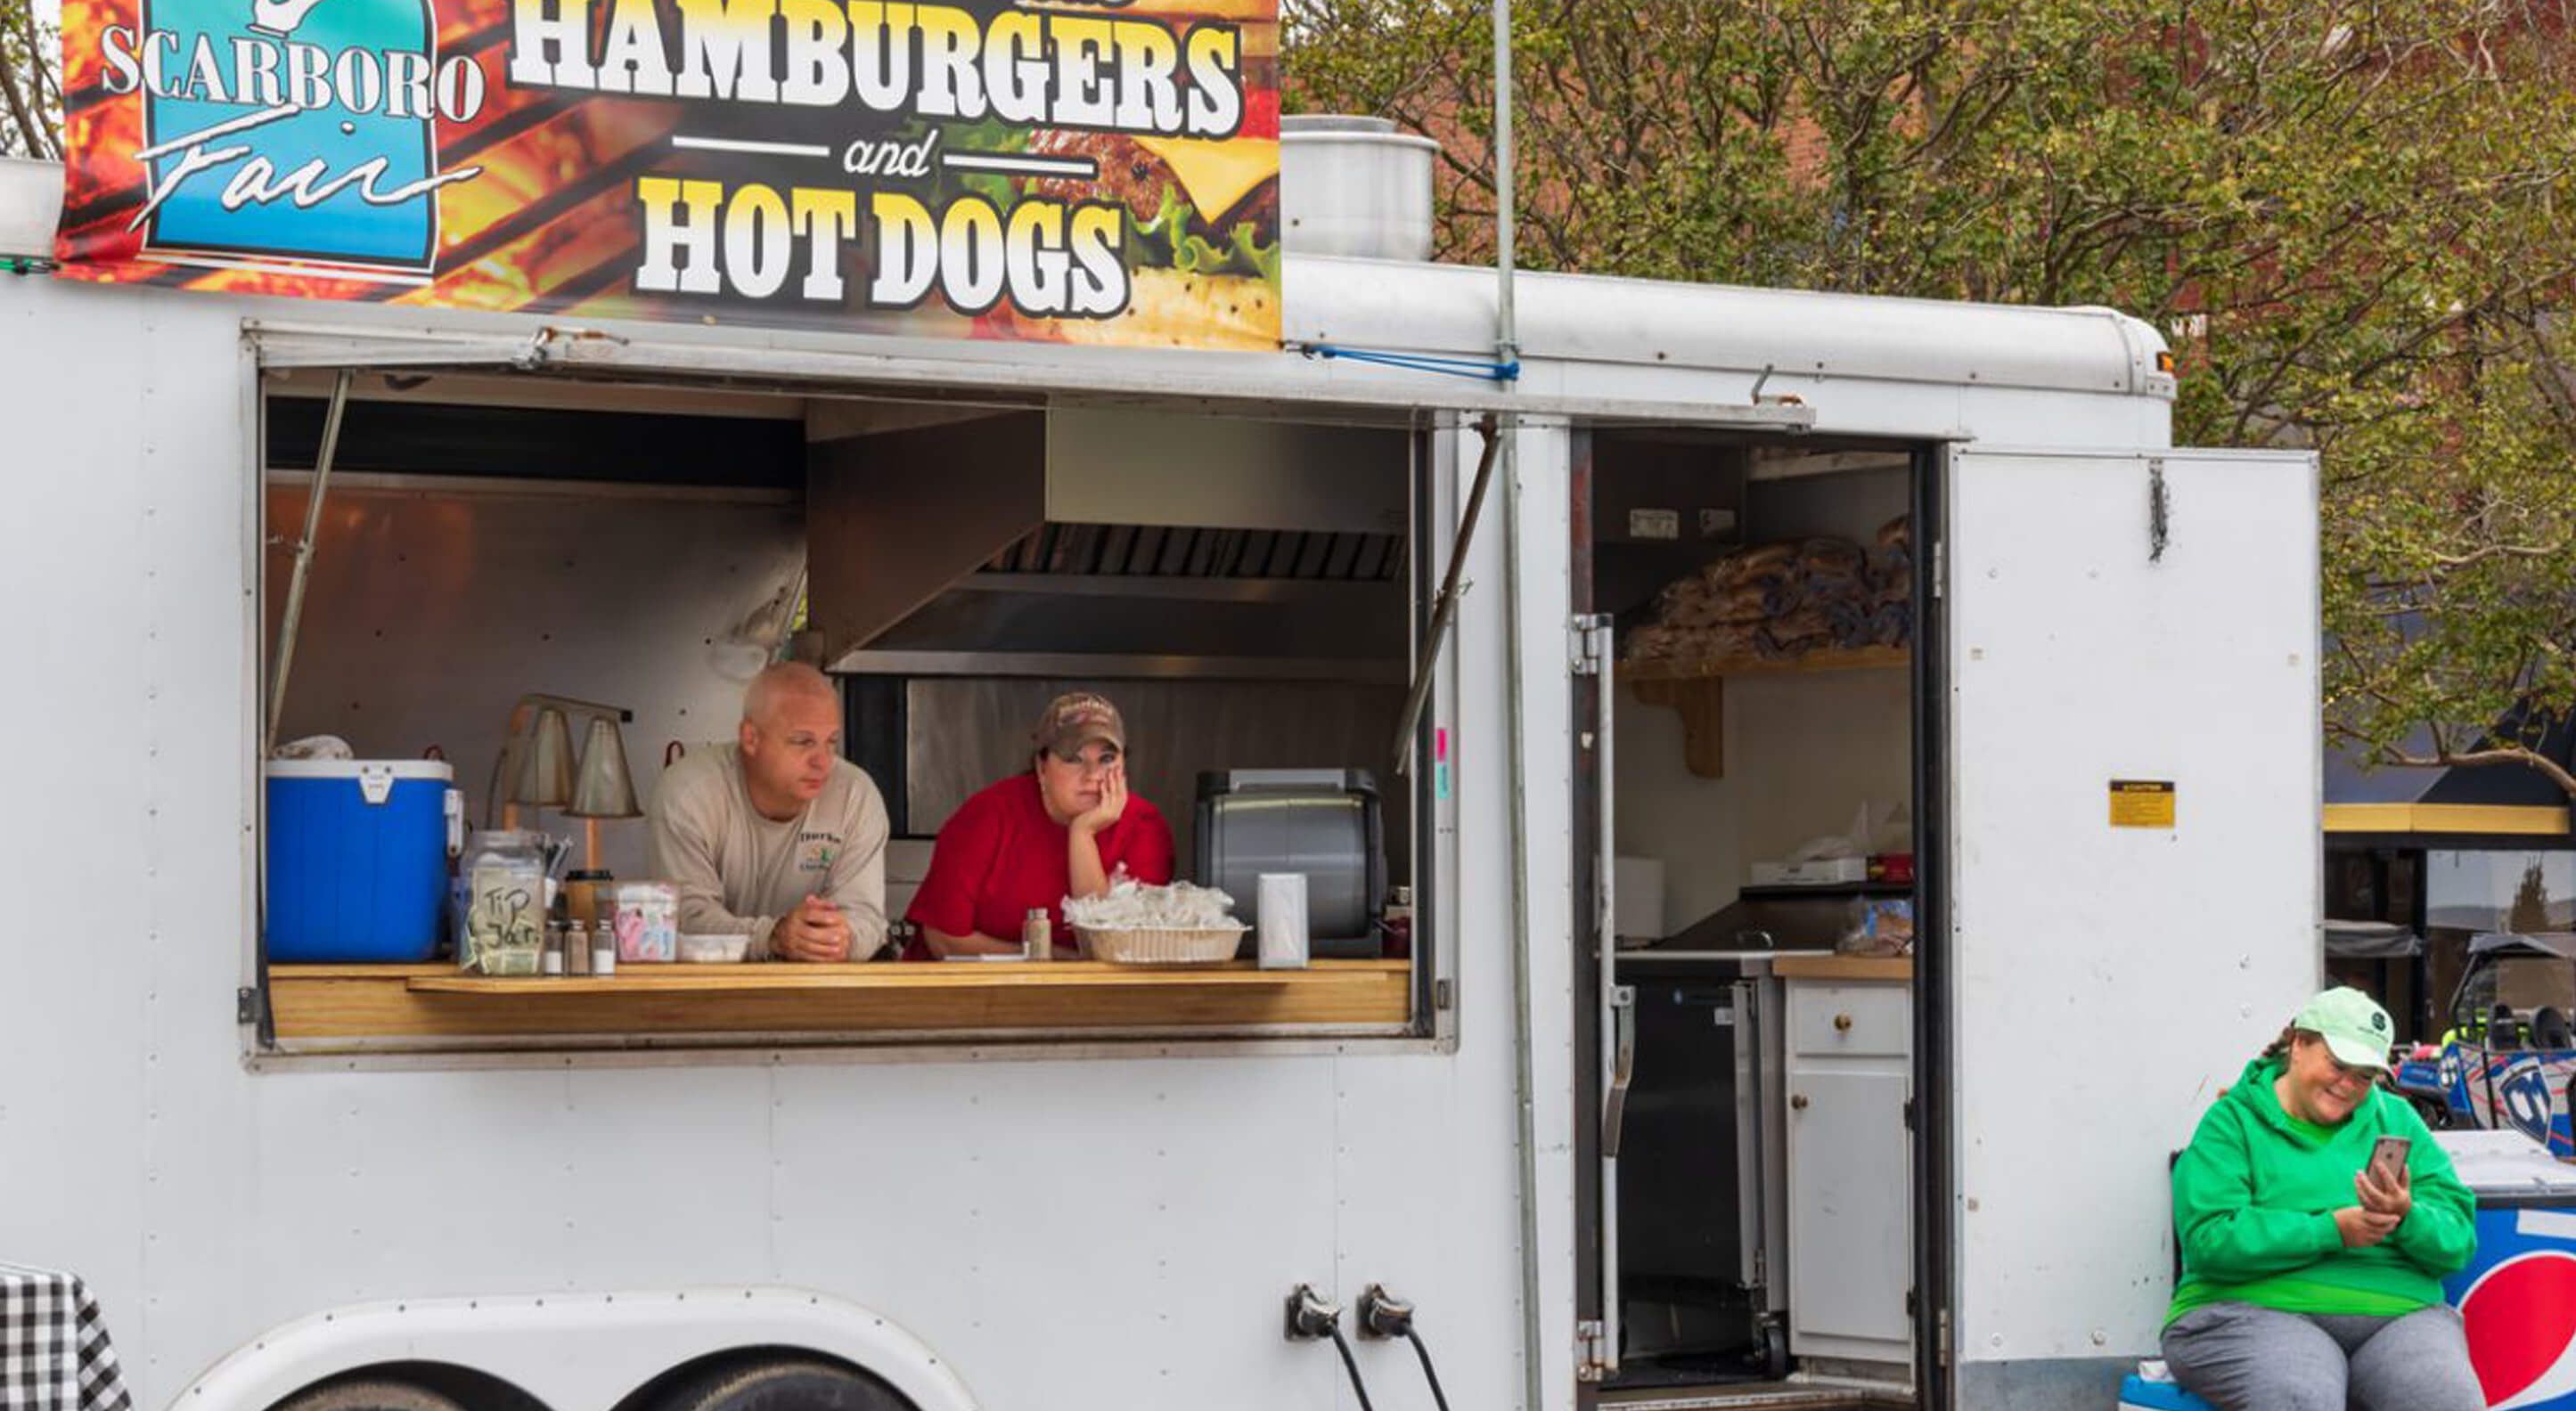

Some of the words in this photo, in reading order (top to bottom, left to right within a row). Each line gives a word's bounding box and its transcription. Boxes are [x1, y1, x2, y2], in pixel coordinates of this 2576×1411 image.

[100, 23, 485, 123] SCARBORO
[511, 0, 1242, 135] HAMBURGERS
[128, 102, 484, 234] Fair
[843, 128, 938, 177] and
[636, 177, 856, 302] HOT
[872, 192, 1125, 316] DOGS
